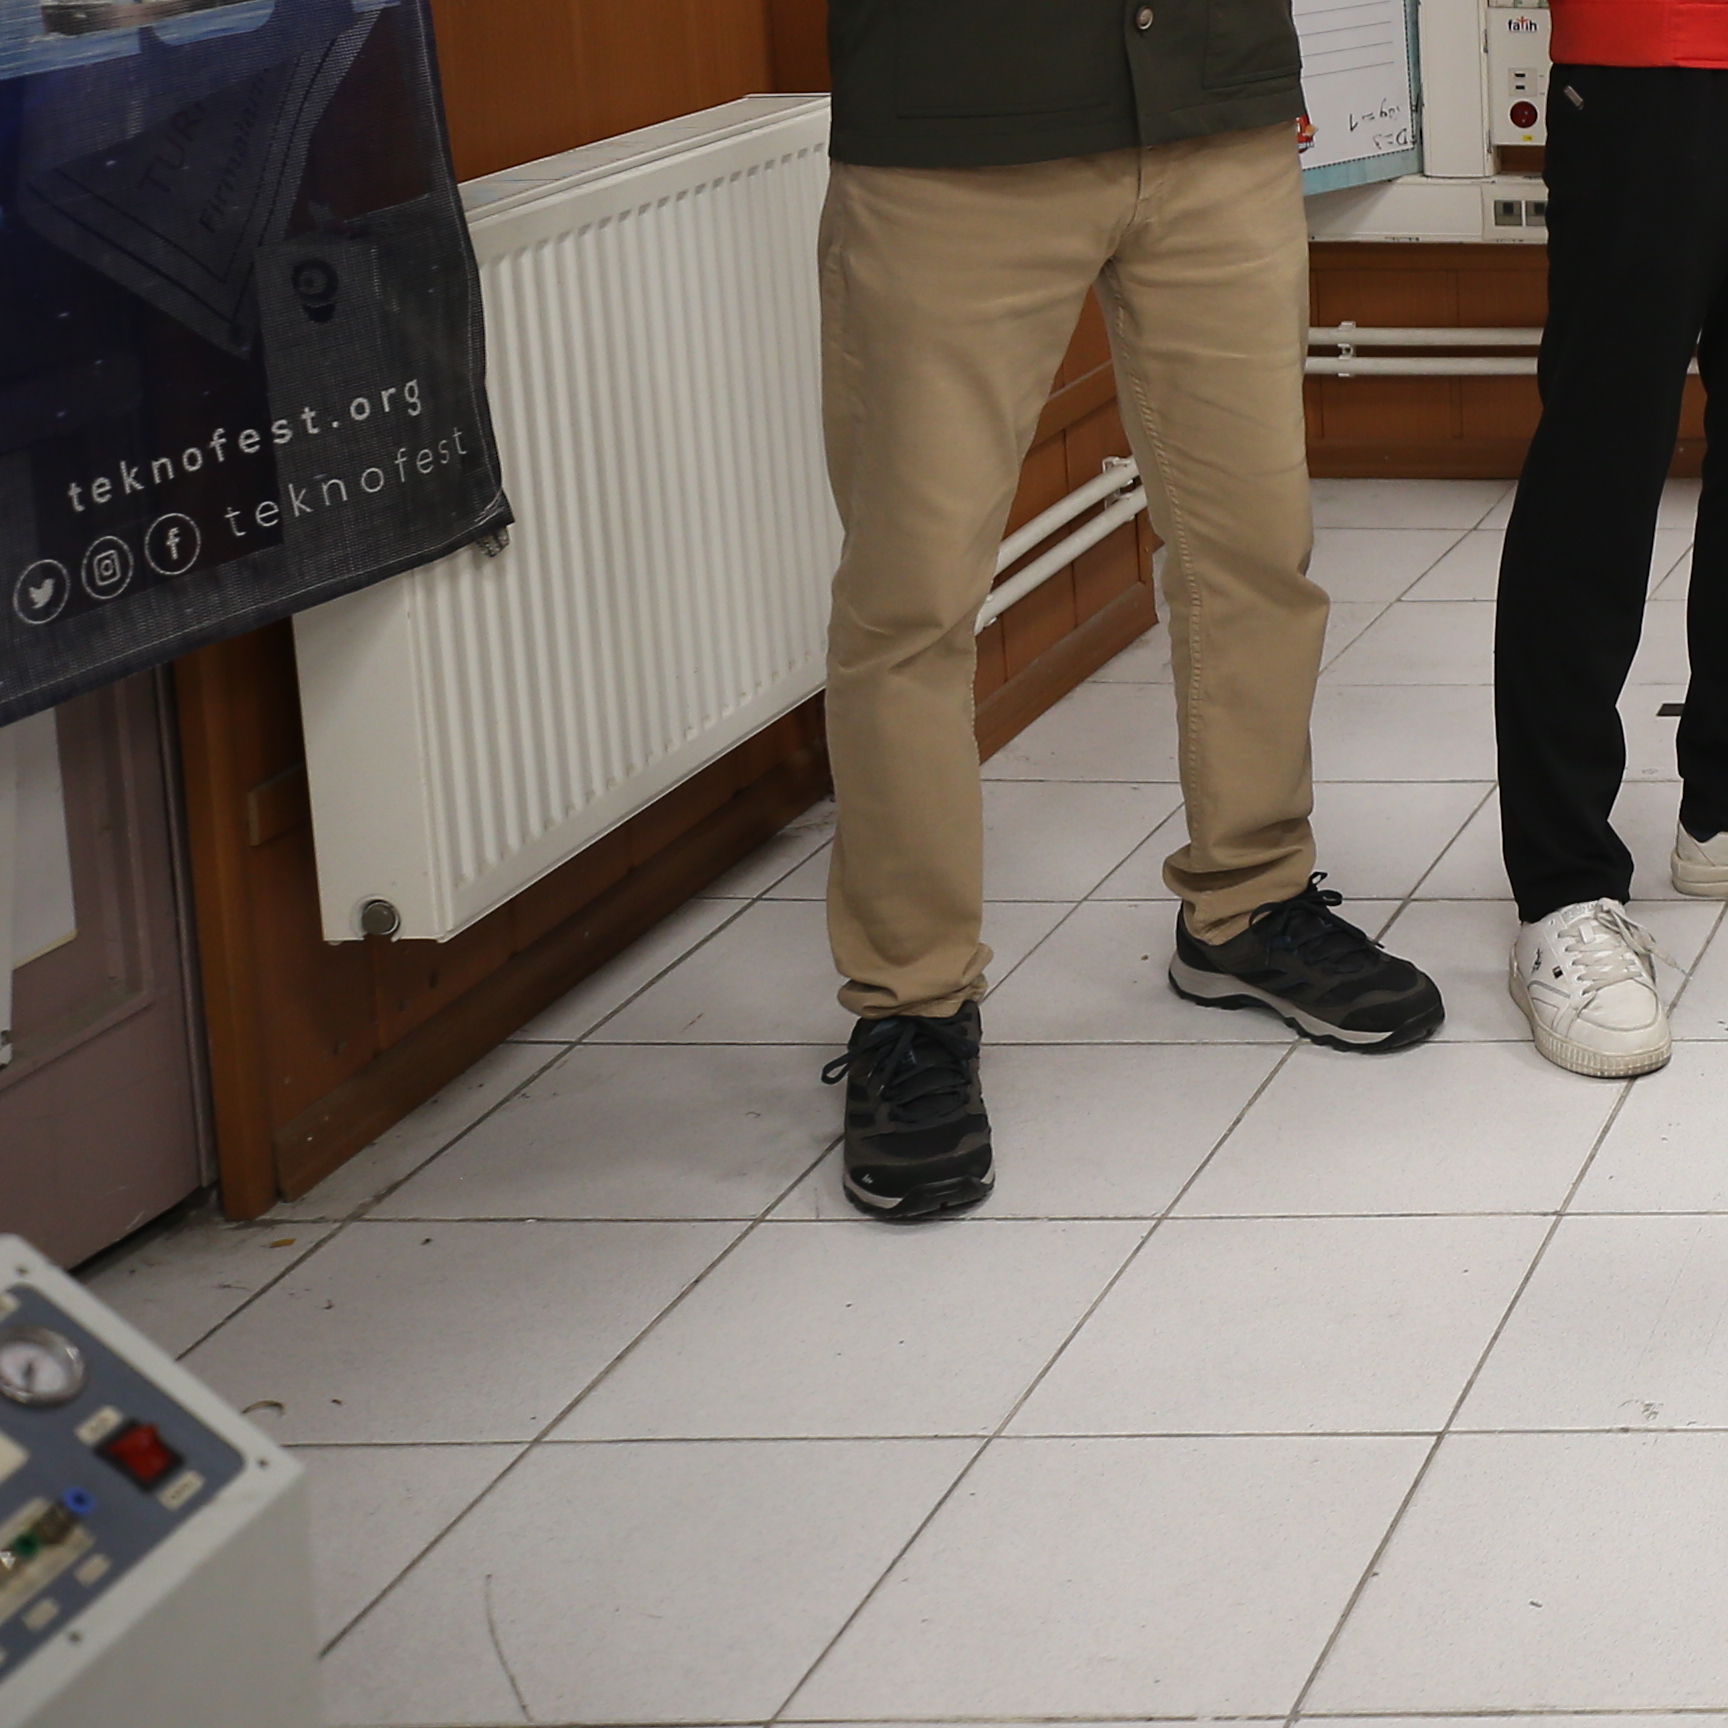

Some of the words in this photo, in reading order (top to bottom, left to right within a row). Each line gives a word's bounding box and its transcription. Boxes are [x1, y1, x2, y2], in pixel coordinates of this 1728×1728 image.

[1507, 15, 1538, 33] fatih
[67, 374, 424, 512] teknofest.org
[224, 425, 471, 539] teknofest
